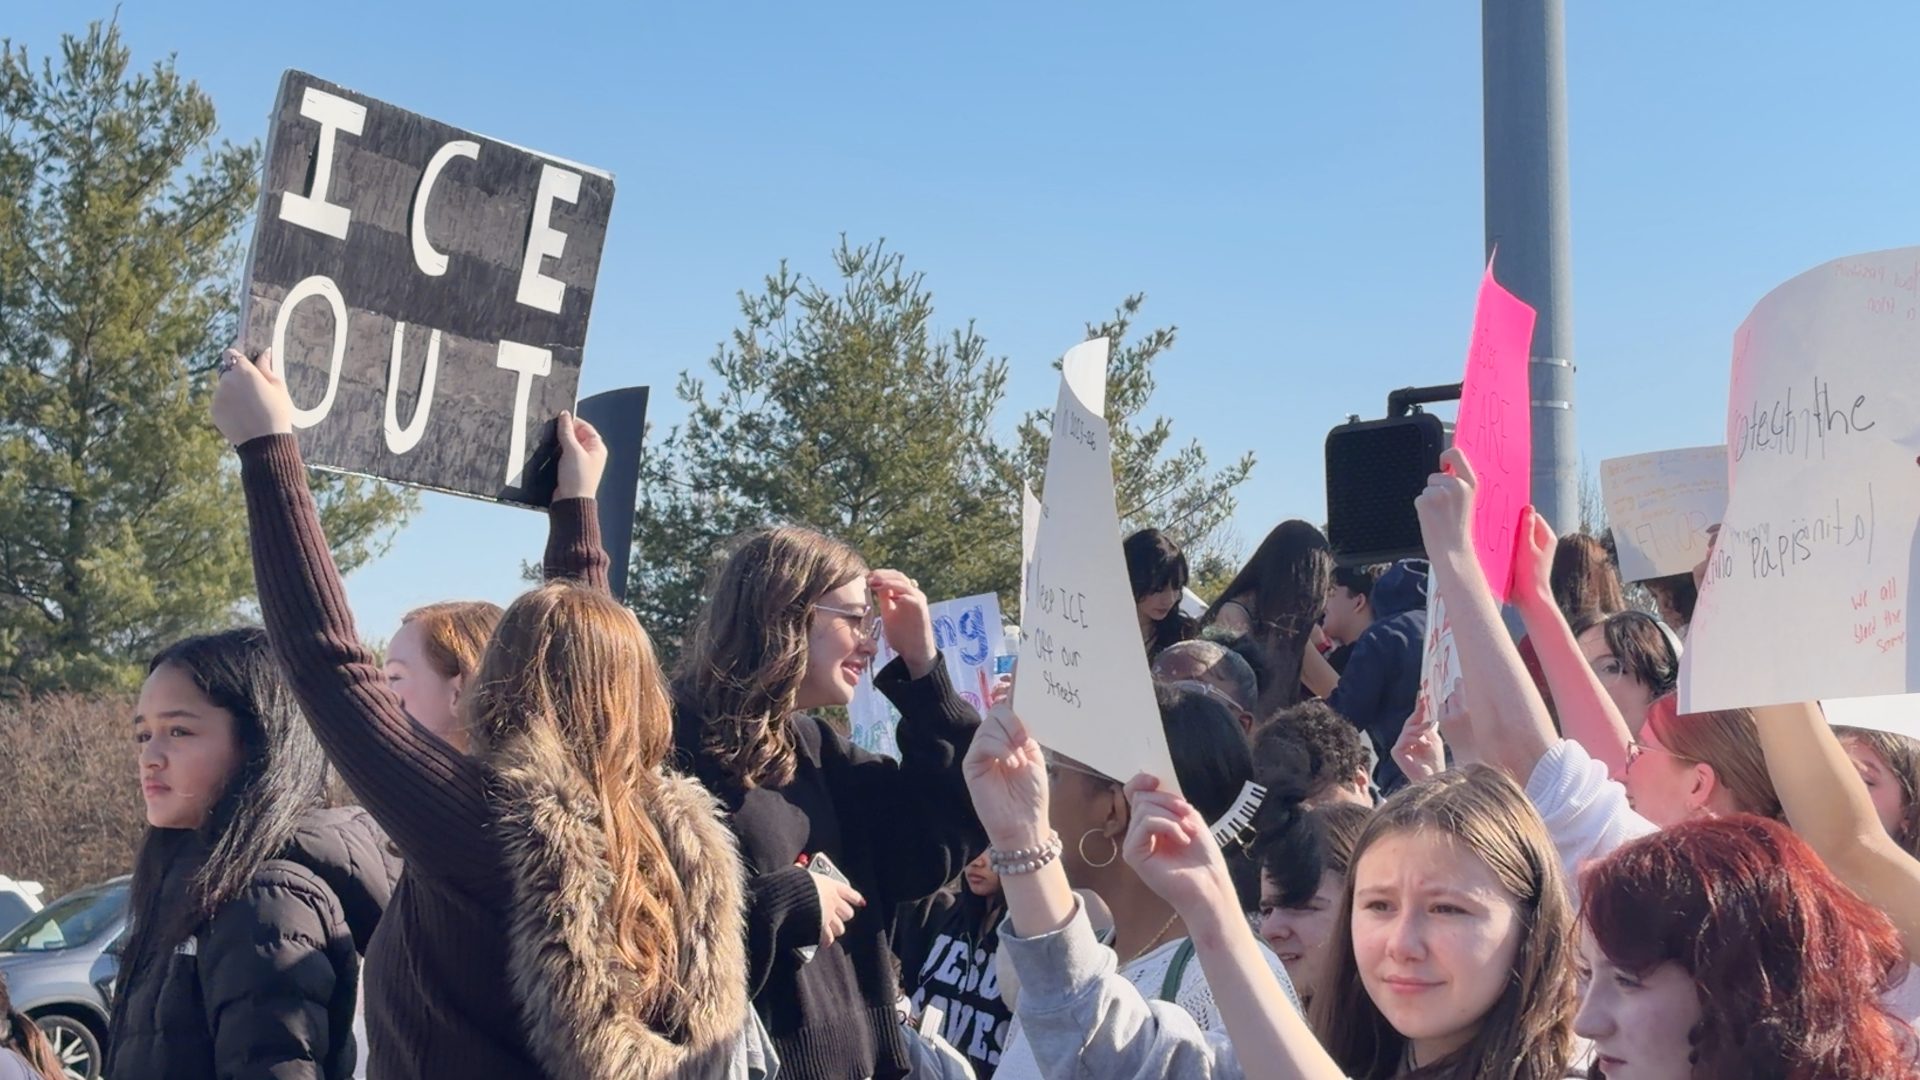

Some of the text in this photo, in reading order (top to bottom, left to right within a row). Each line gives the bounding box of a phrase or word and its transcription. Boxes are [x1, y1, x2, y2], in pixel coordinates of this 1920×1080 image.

[279, 87, 582, 314] ICE
[272, 275, 553, 488] OUT
[1812, 375, 1876, 439] the
[1058, 587, 1089, 629] ICE
[1879, 575, 1897, 601] all
[1061, 645, 1081, 668] our
